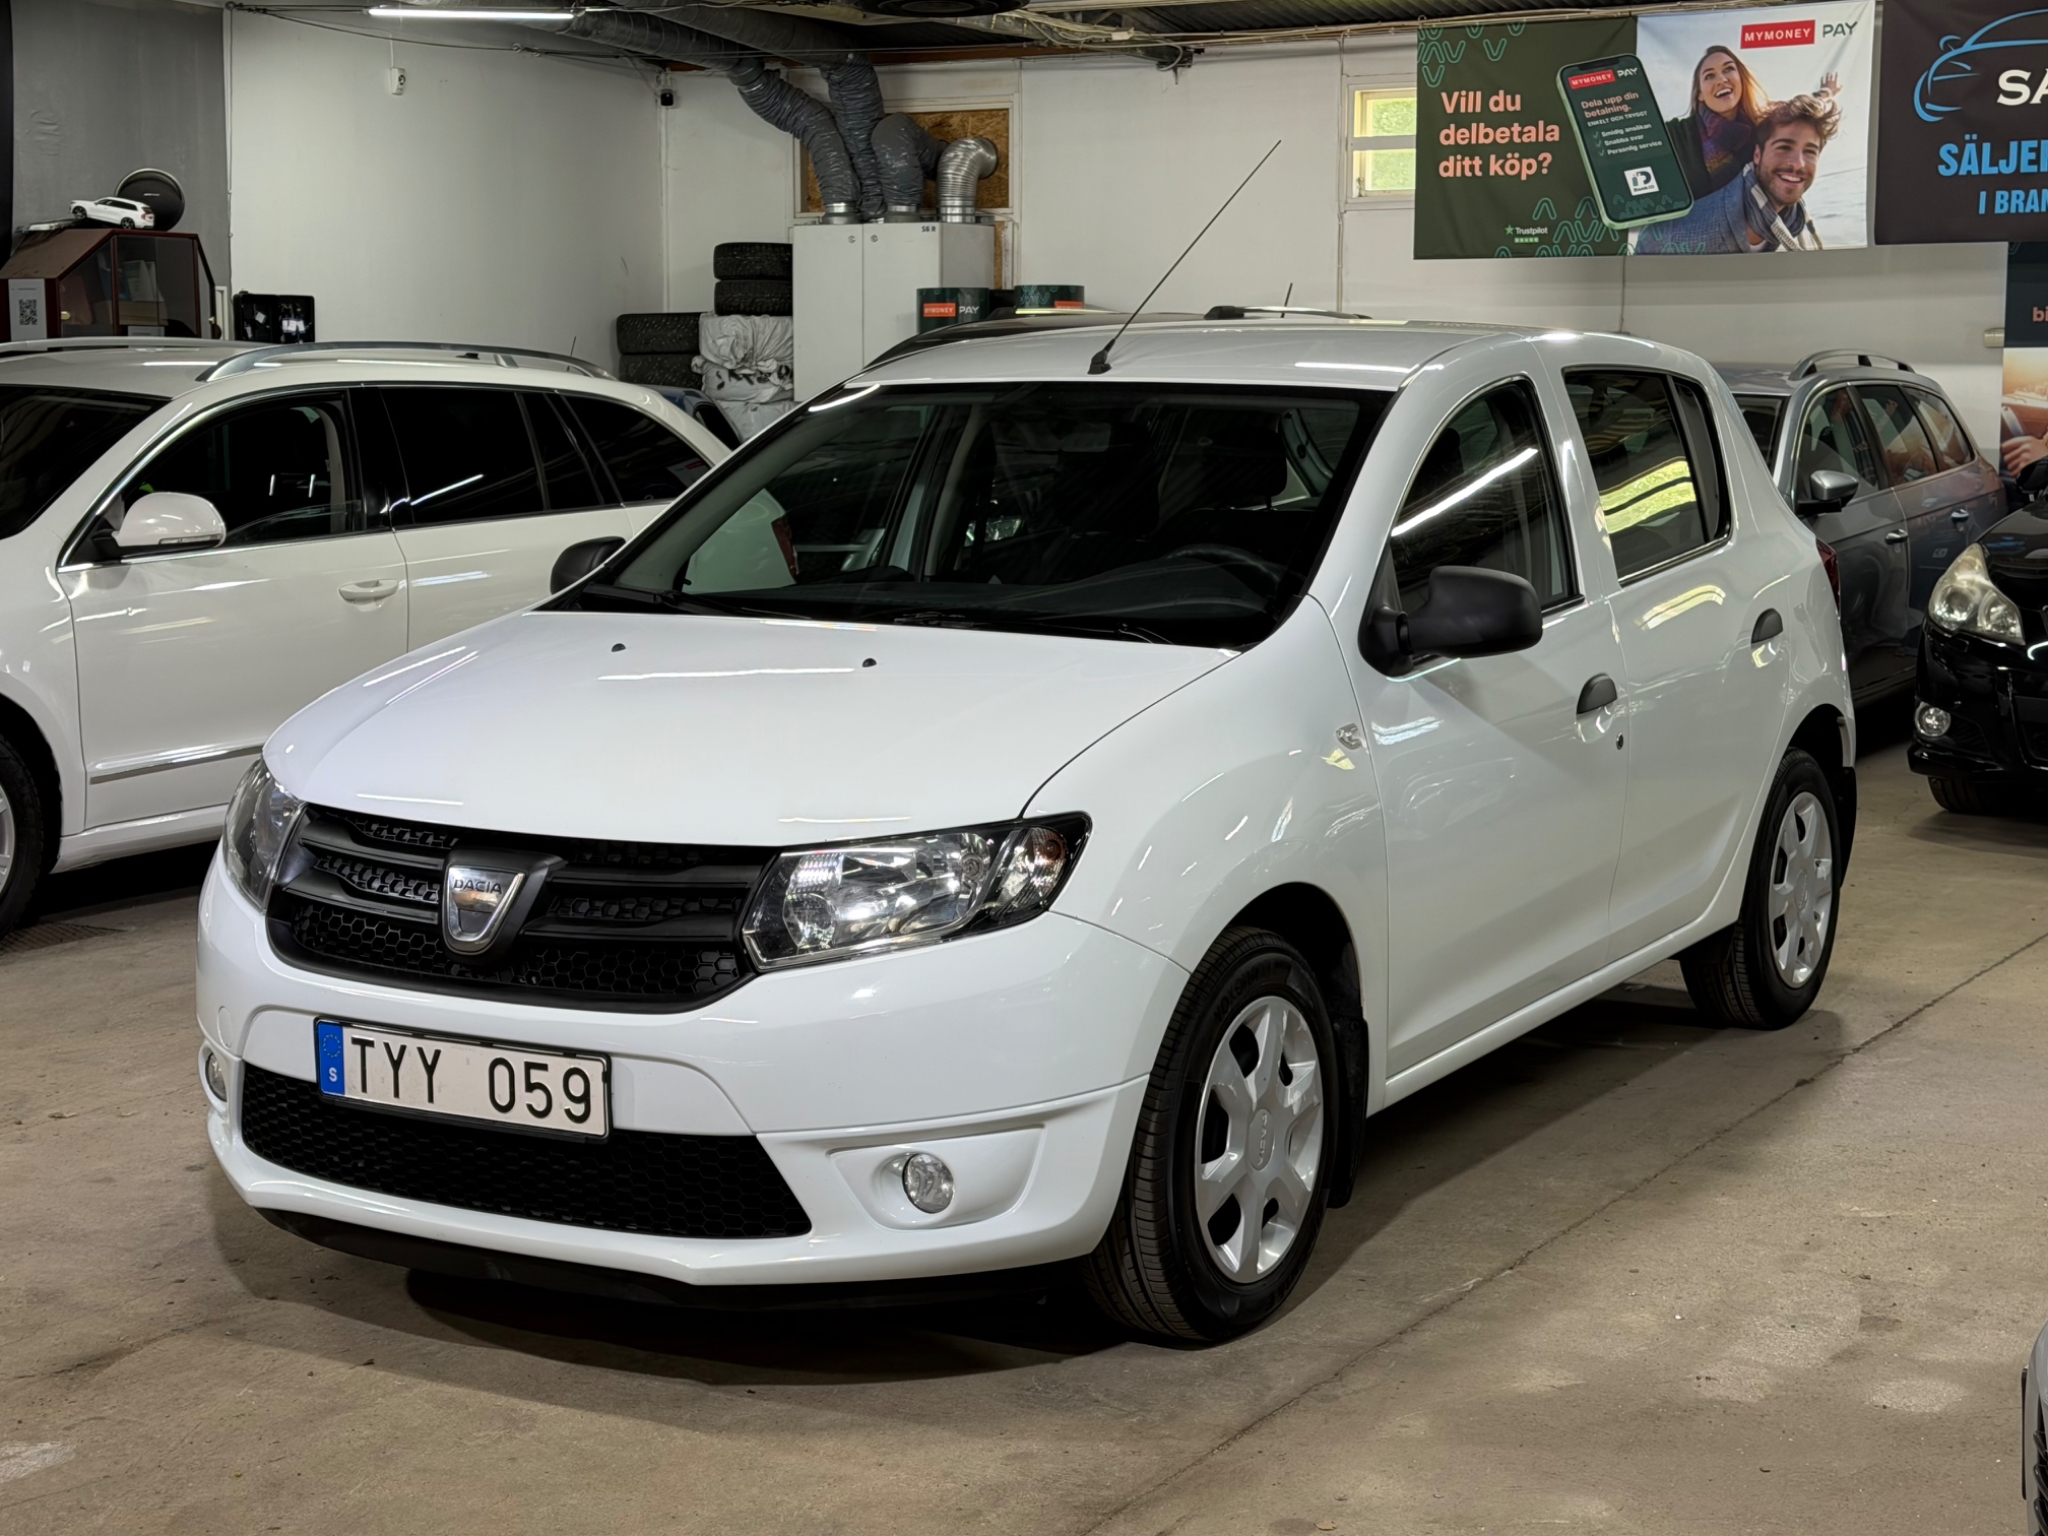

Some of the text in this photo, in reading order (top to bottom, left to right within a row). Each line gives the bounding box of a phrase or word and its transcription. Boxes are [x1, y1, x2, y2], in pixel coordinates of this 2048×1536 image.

[1744, 21, 1858, 42] MYMONEY PAY
[1571, 67, 1638, 85] MYMONEY PAY
[1440, 90, 1521, 114] Vill du
[1581, 92, 1639, 109] Dela upp din
[1439, 120, 1560, 145] delbetala
[1601, 128, 1624, 137] Smidig
[1604, 137, 1629, 146] Snabba
[1607, 141, 1663, 155] Personlig service
[1438, 152, 1553, 181] ditt köp?
[1978, 190, 1987, 214] I
[1515, 227, 1548, 236] Trustpilot
[959, 306, 979, 314] PAY
[453, 879, 502, 894] DACIA
[328, 1067, 338, 1082] S
[351, 1035, 591, 1124] TYY 059
